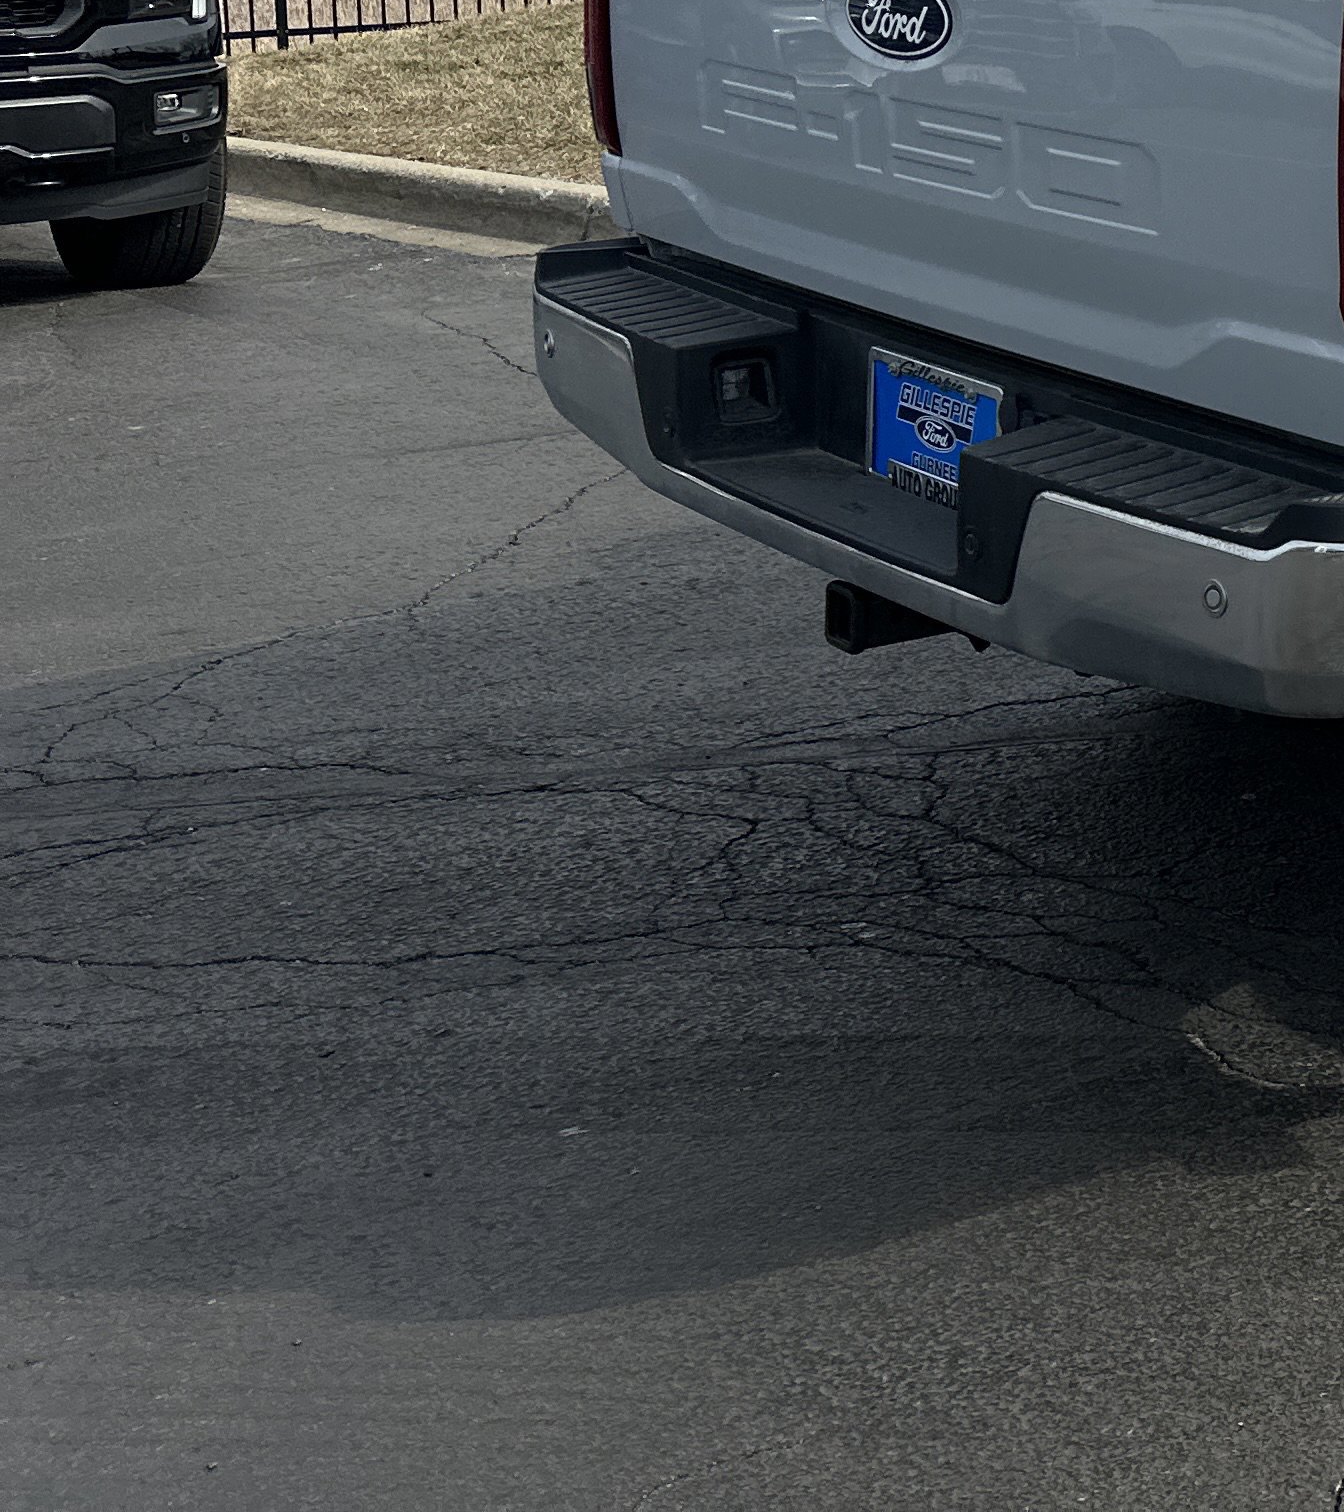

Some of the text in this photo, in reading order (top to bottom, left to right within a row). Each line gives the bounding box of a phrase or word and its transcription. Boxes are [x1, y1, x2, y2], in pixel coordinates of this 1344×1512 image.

[698, 59, 1162, 235] F-150
[899, 382, 977, 426] GILLESPIE
[922, 421, 949, 448] Ford
[892, 465, 959, 511] AUTO GROU
[911, 451, 959, 482] GURNEE
